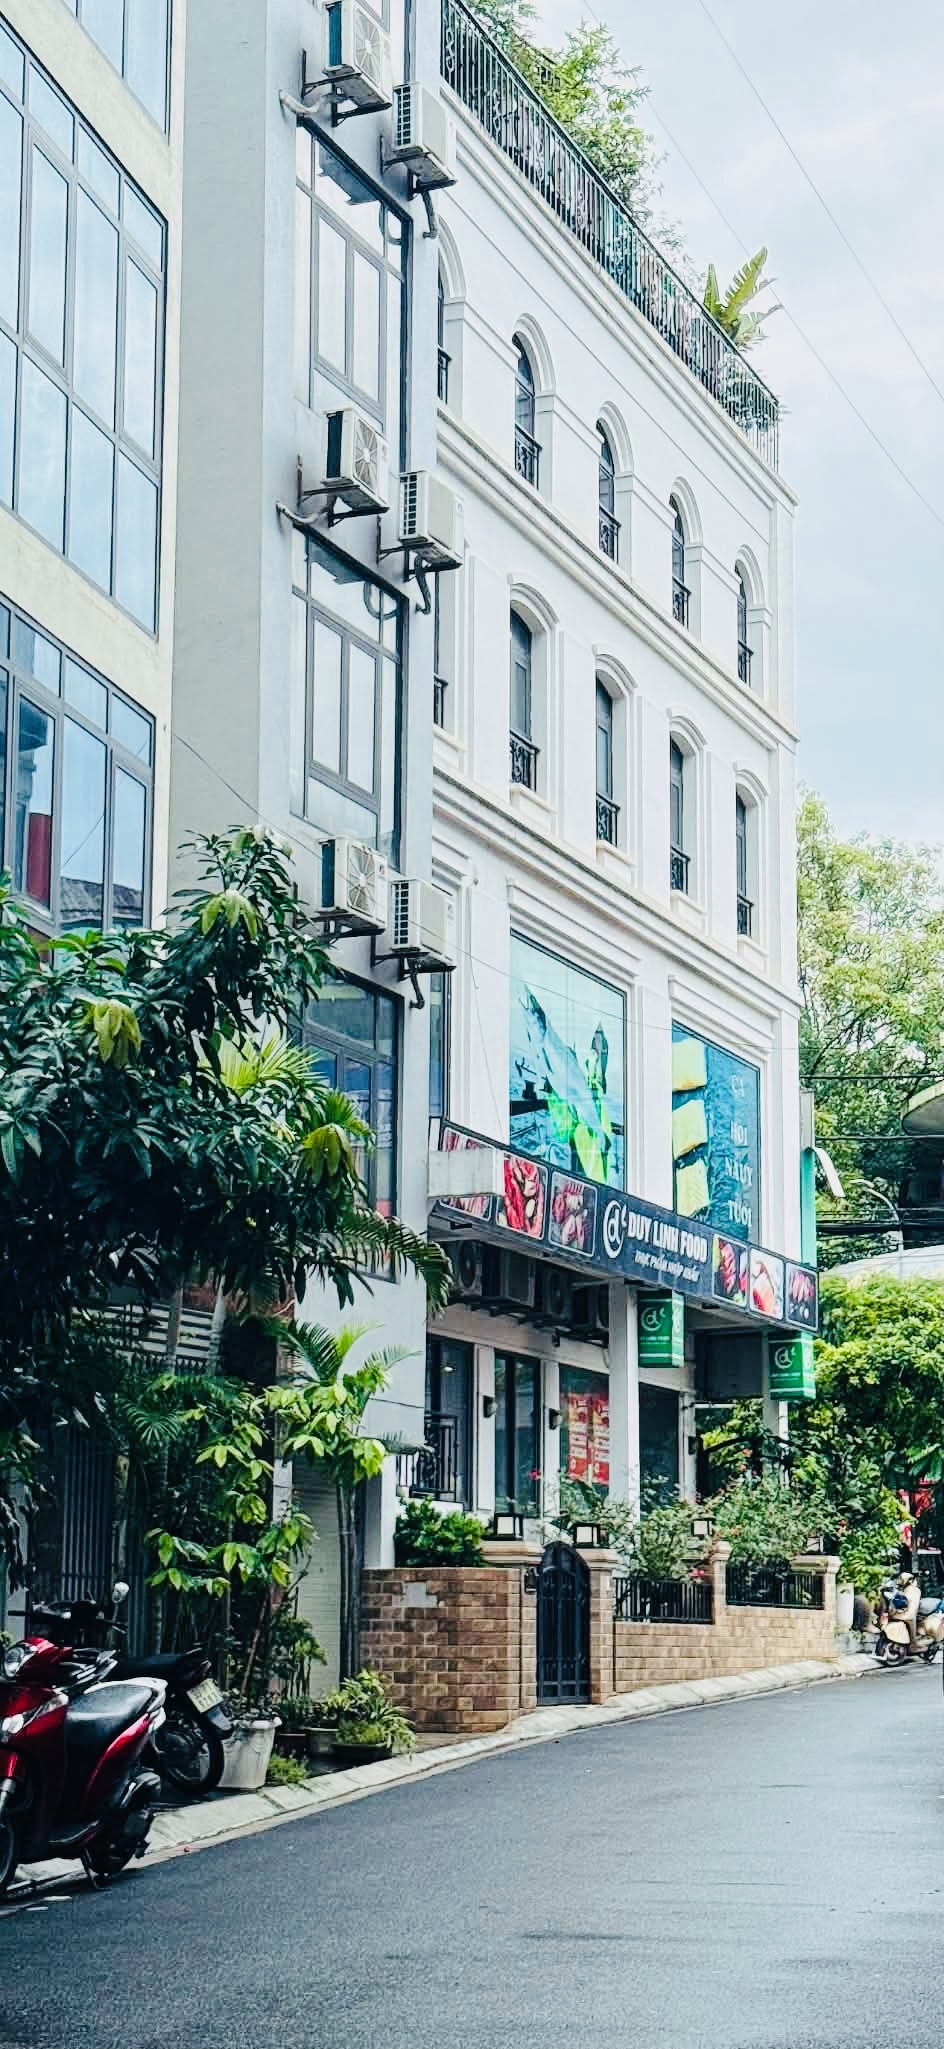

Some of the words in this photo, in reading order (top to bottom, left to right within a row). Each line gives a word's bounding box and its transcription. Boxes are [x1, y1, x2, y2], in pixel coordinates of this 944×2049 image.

[628, 1212, 652, 1242] DUY
[653, 1220, 679, 1252] LINH
[680, 1230, 707, 1263] FOOD
